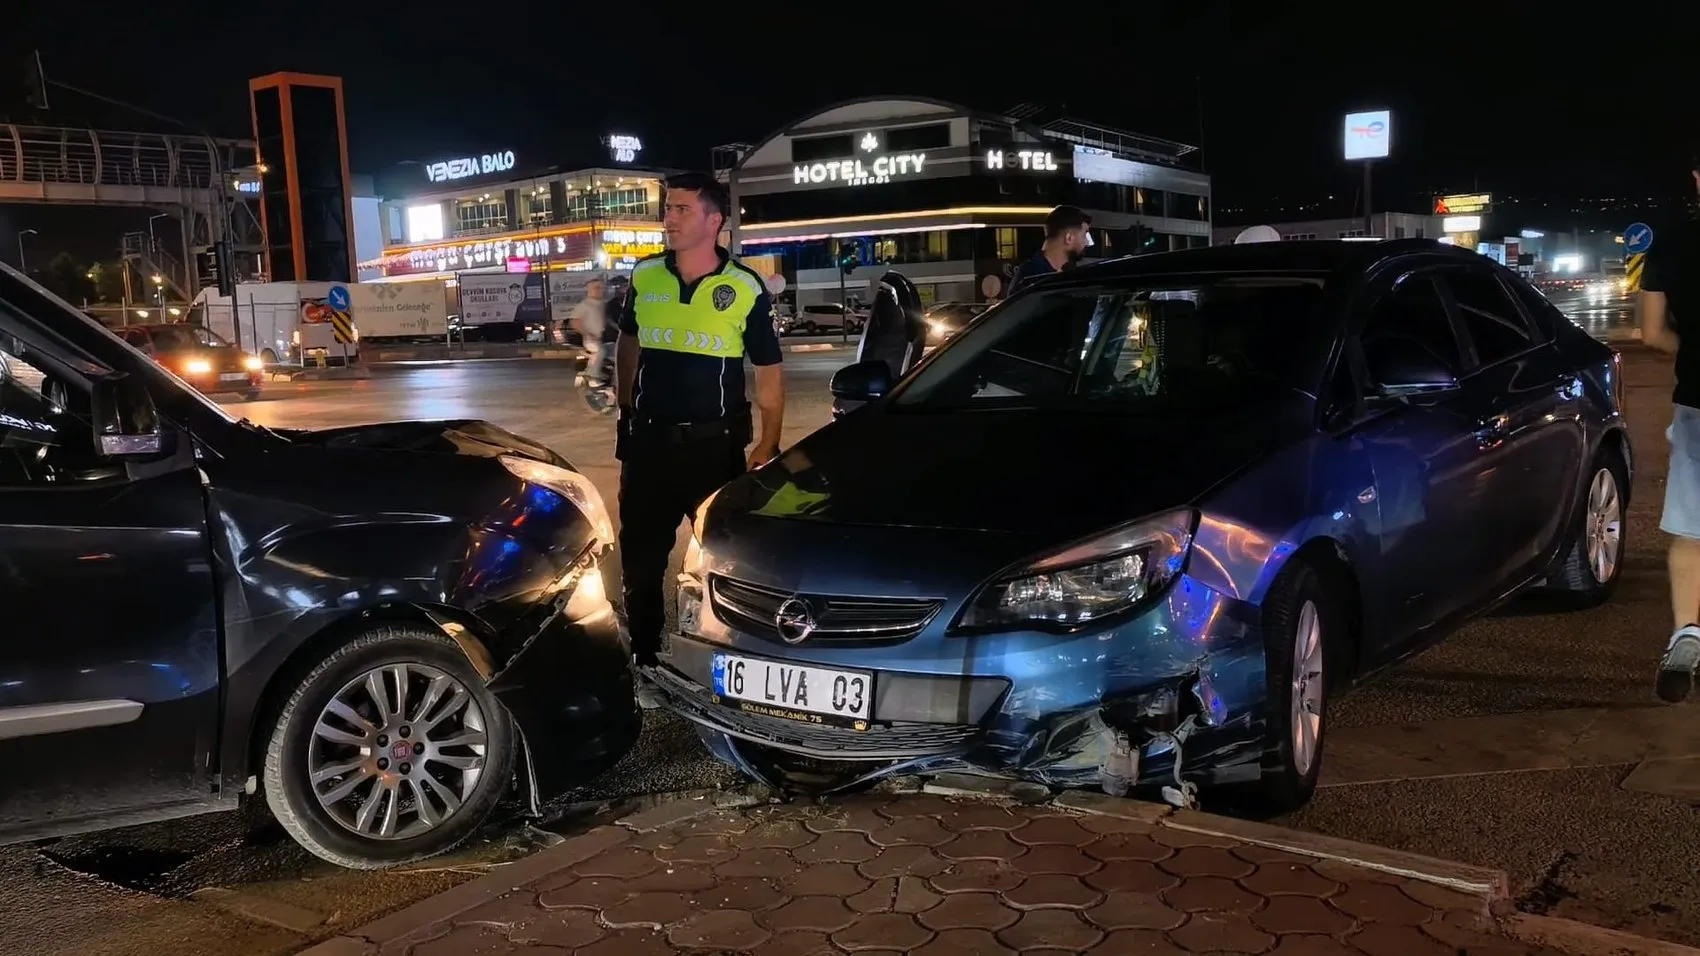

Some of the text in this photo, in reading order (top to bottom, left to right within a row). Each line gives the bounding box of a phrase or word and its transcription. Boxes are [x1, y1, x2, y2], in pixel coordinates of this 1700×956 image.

[426, 150, 515, 182] VENEZIA BALO
[794, 153, 926, 185] HOTEL CITY
[727, 660, 865, 714] 16 LVA 03
